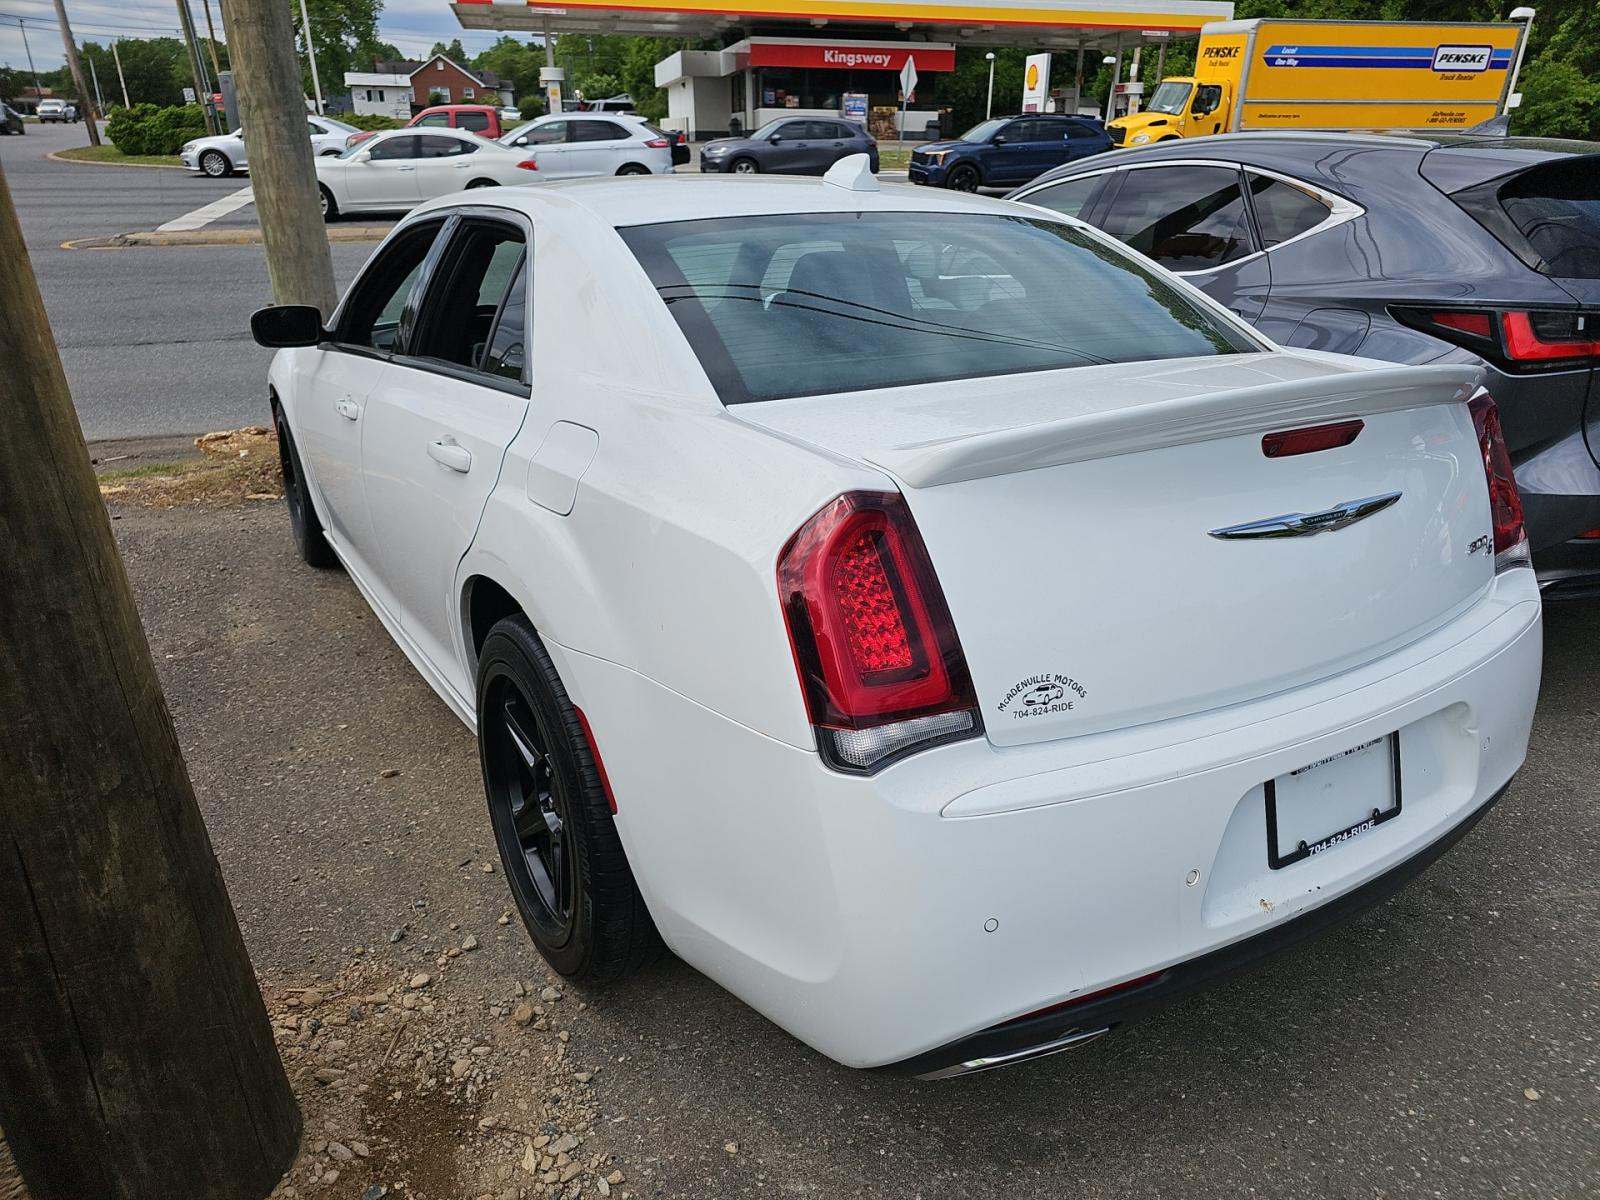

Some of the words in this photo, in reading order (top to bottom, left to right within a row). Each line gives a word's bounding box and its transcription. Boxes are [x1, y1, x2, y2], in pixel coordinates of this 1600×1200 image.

[824, 50, 891, 67] Kingsway
[1202, 46, 1240, 58] PENSKE
[1281, 46, 1298, 54] Local
[1438, 53, 1487, 63] PENSKE
[1054, 674, 1087, 698] MOTORS
[1013, 701, 1074, 719] 704-824-RIDE
[1308, 819, 1376, 857] 704-824-RIDE
